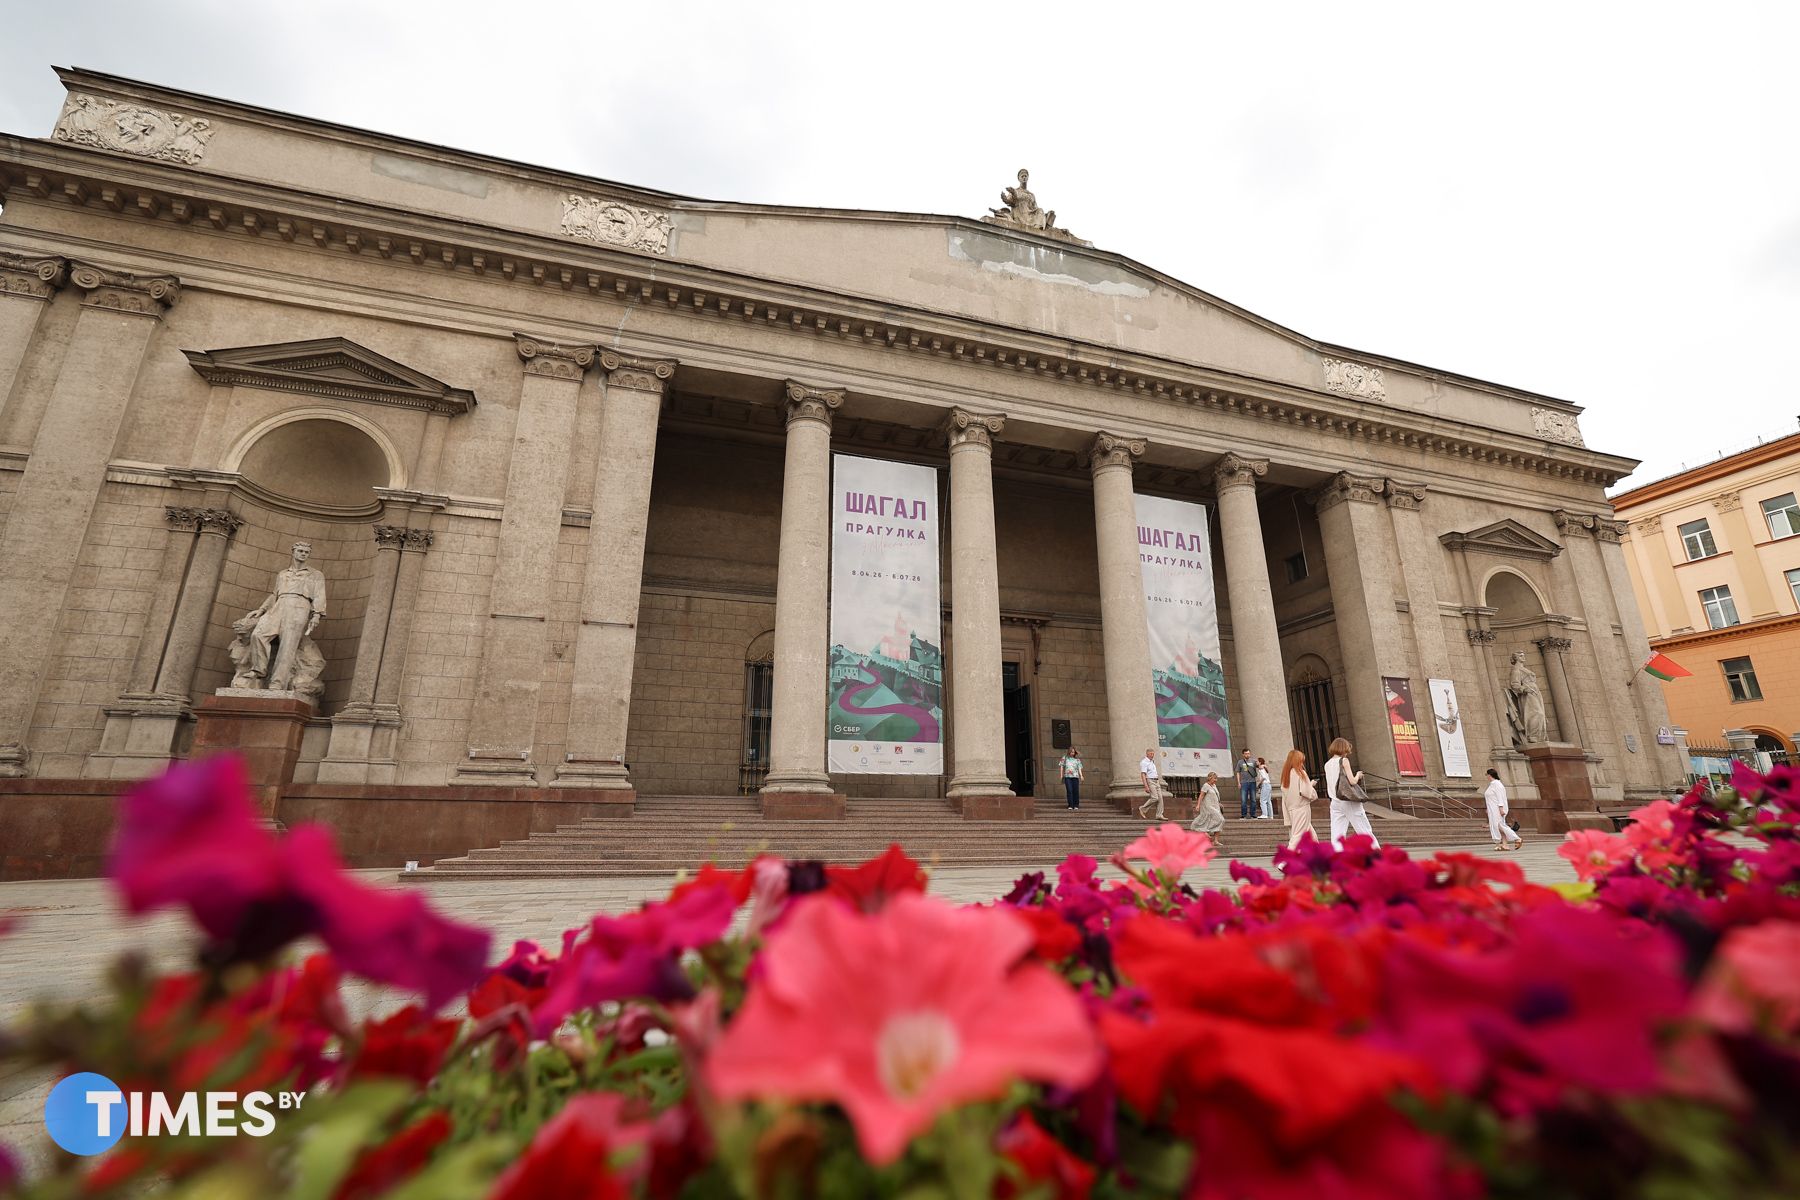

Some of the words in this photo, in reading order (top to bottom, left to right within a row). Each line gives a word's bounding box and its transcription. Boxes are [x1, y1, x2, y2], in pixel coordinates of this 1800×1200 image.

[846, 491, 926, 521] ШАГАЛ
[846, 522, 926, 541] ПРАГУЛКА
[1136, 525, 1201, 553] ШАГАЛ
[1140, 553, 1202, 571] ПРАГУЛКА
[1392, 724, 1418, 736] МОДЫ
